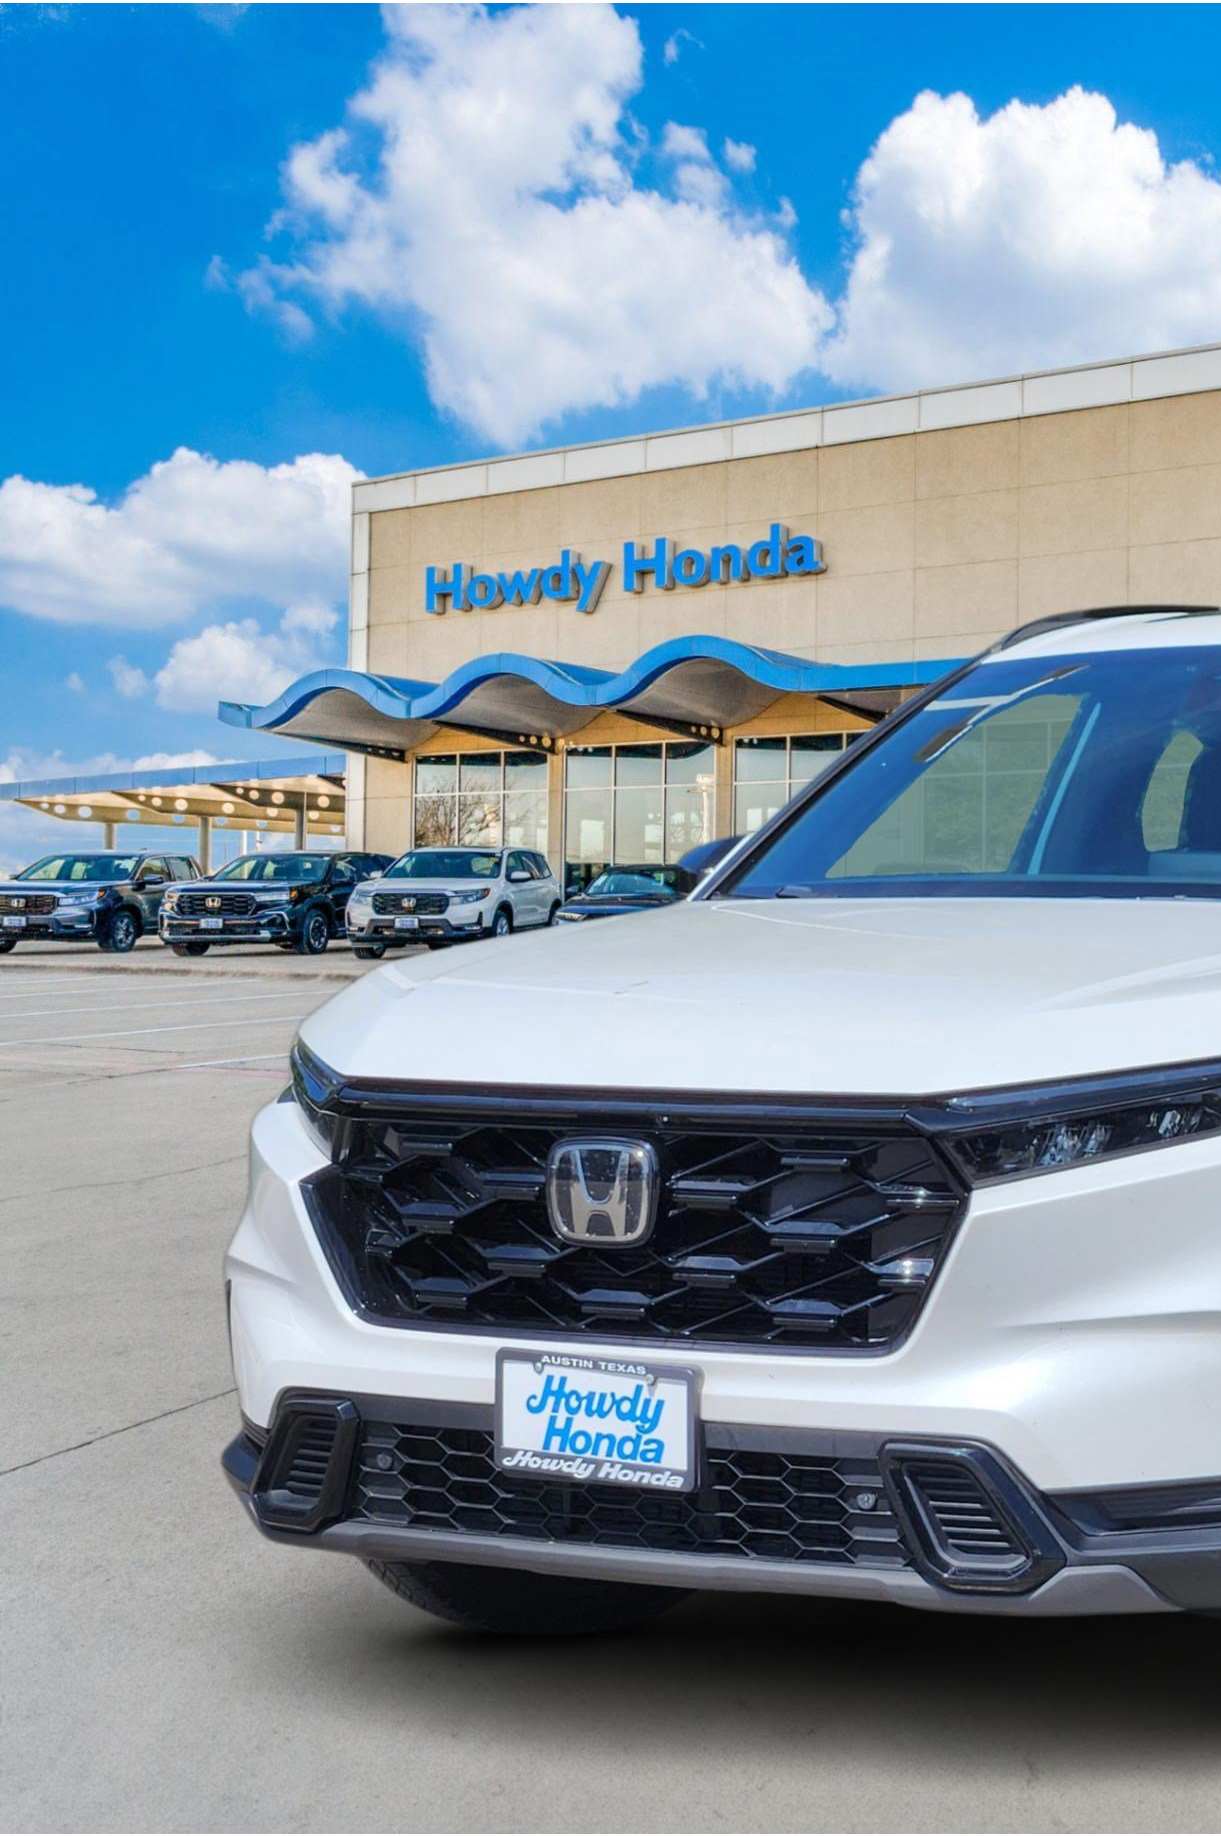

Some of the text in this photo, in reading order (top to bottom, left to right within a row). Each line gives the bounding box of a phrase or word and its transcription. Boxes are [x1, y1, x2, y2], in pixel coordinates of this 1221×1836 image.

[425, 523, 825, 614] Howdy Honda
[541, 1355, 647, 1375] AUSTIN TEXAS
[526, 1374, 665, 1434] Howdy
[542, 1415, 665, 1464] Honda
[502, 1450, 684, 1488] Howdy Honda
